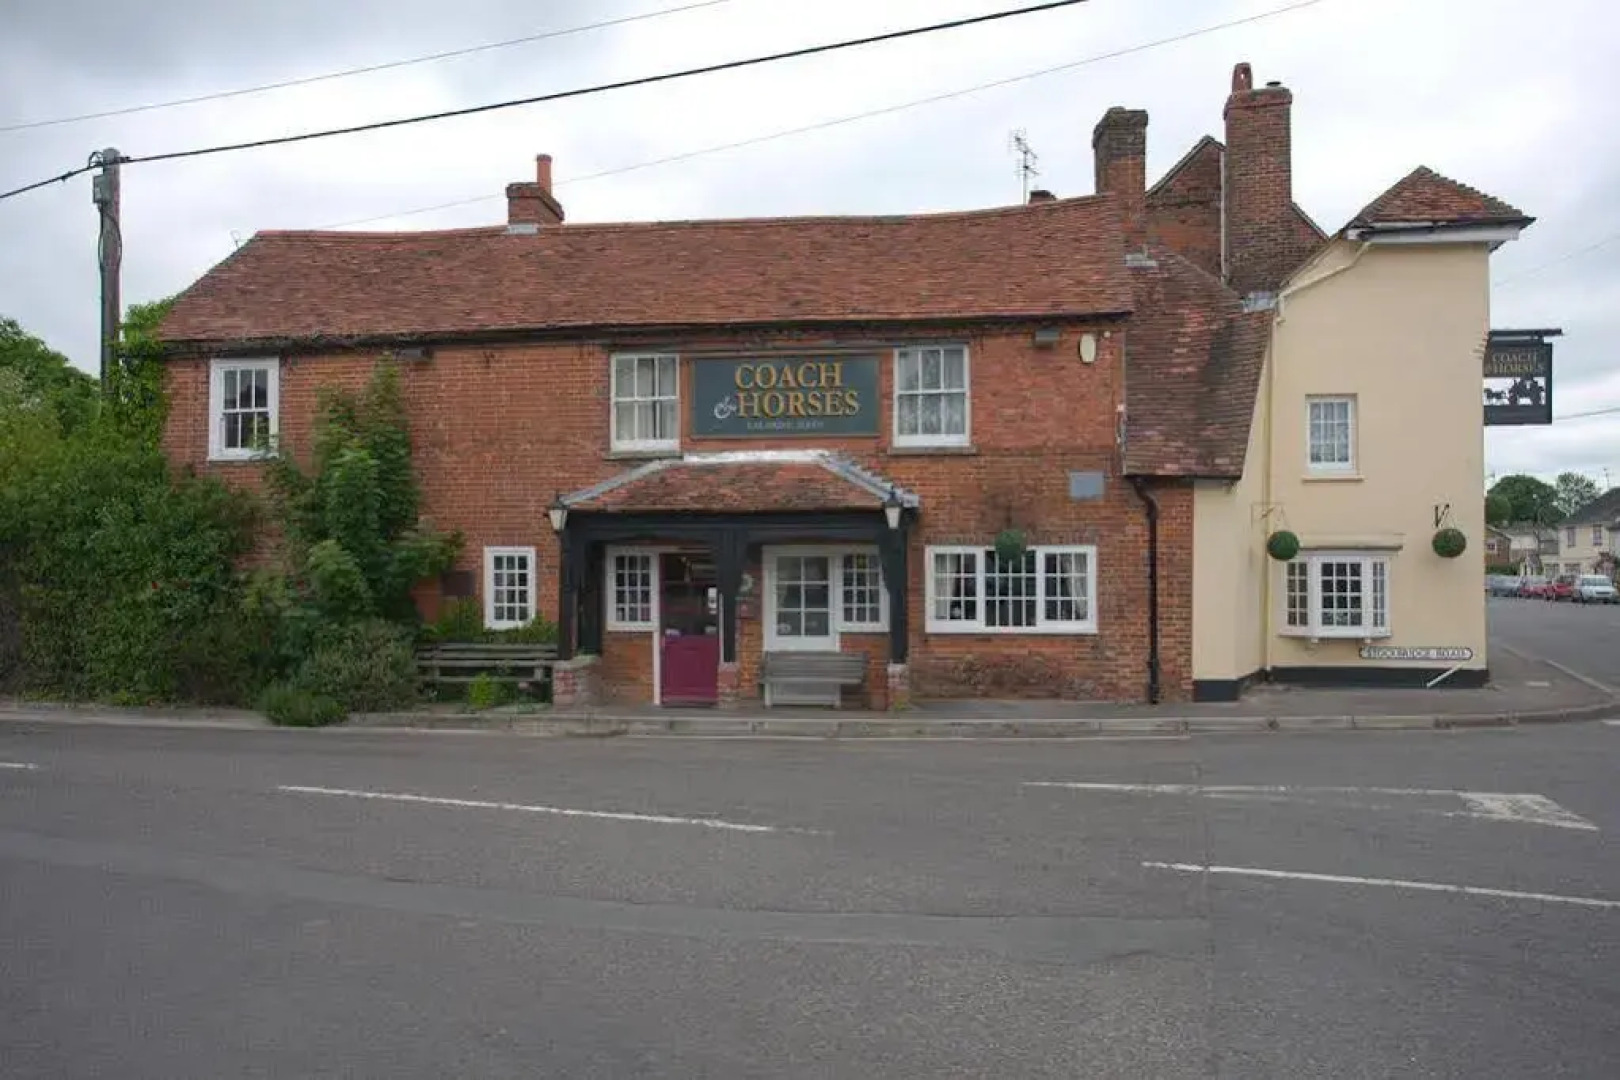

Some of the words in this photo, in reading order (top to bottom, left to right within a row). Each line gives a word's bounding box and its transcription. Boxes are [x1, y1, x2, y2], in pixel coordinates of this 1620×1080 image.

[1493, 352, 1537, 363] COACH
[735, 362, 843, 389] COACH
[714, 396, 737, 419] &
[736, 391, 860, 418] HORSES
